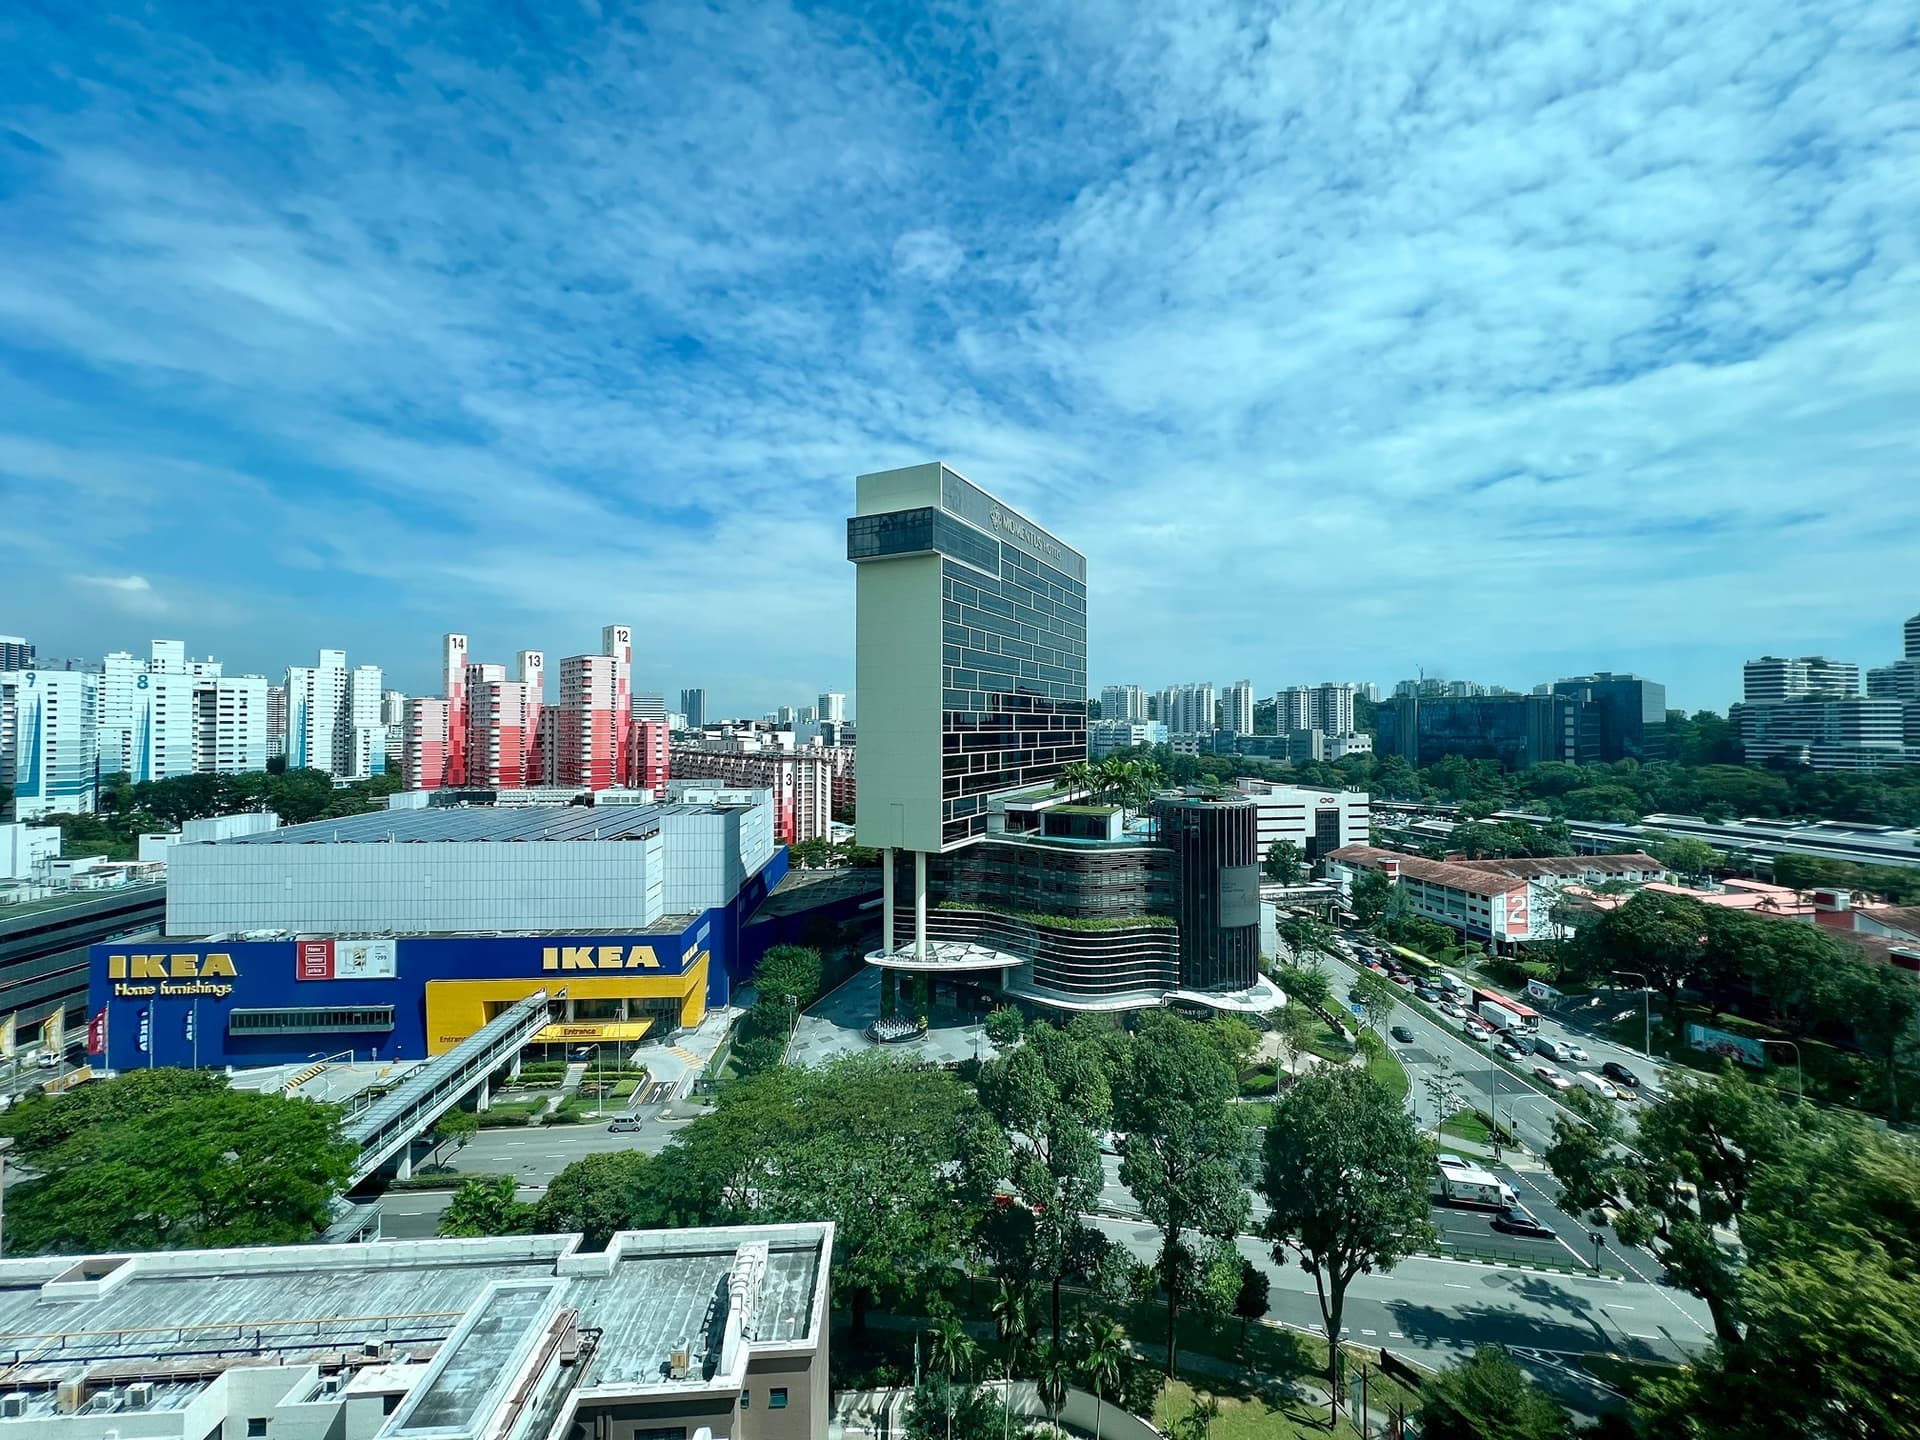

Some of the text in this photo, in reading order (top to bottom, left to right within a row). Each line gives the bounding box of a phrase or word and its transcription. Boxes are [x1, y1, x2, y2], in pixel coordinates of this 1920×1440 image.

[1001, 515, 1042, 551] MOMENTUS
[452, 637, 464, 650] 14
[617, 630, 628, 643] 12
[528, 654, 541, 667] 13
[25, 672, 37, 688] 9
[137, 674, 149, 690] 8
[785, 773, 793, 786] 3
[1508, 895, 1527, 924] 2
[543, 945, 660, 970] IKEA
[108, 953, 238, 979] IKEA
[114, 980, 233, 997] Home furnishings
[1176, 1008, 1196, 1016] TOAST
